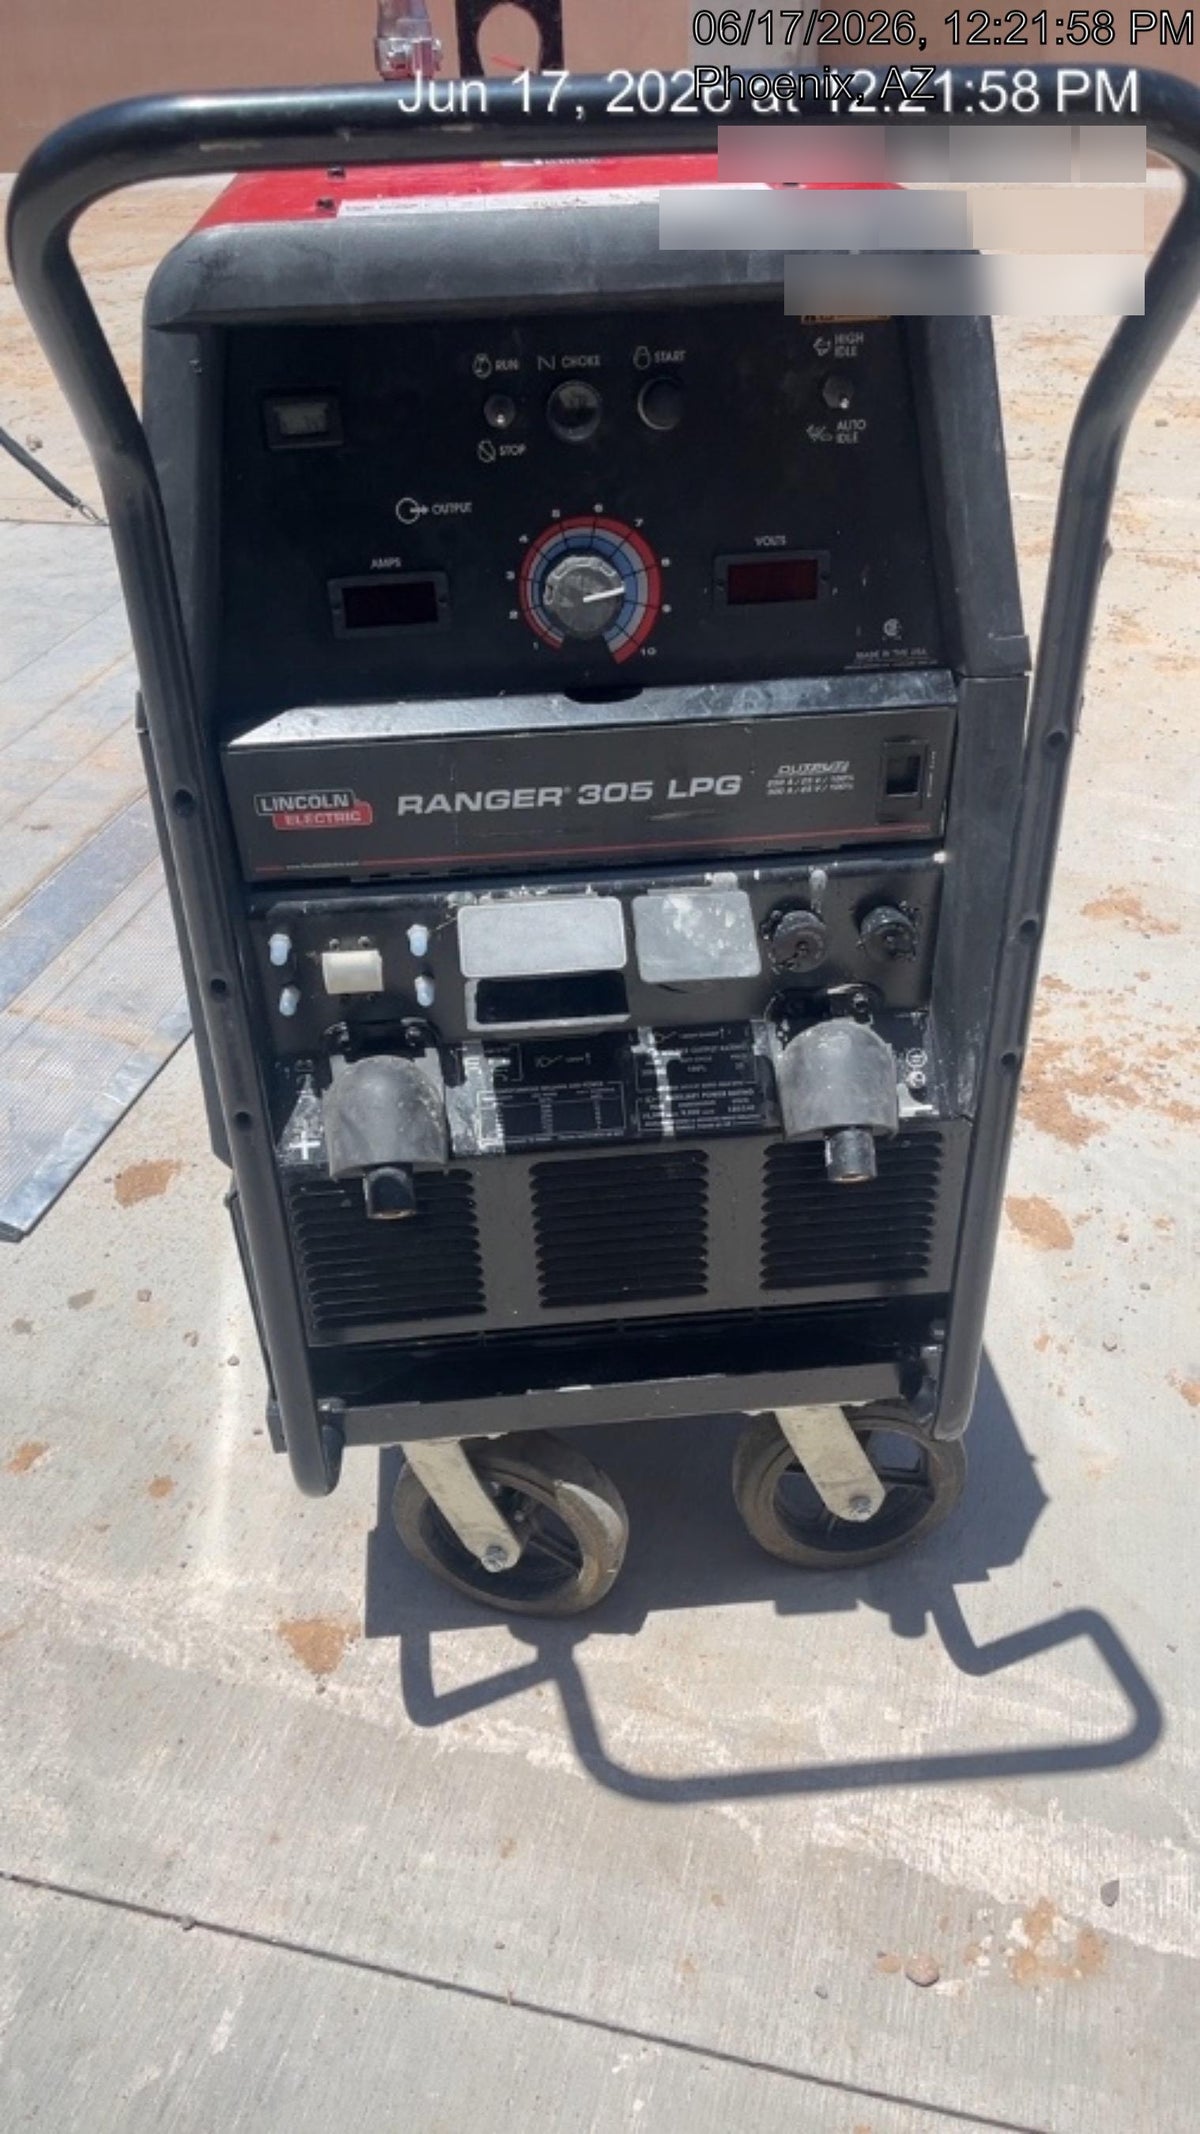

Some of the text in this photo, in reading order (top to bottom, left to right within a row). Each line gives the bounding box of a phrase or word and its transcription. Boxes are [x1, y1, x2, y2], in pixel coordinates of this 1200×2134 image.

[834, 331, 864, 344] HIGH
[561, 355, 600, 369] CHOKE
[654, 350, 687, 364] START
[495, 359, 520, 371] RUN
[836, 419, 866, 431] AUTO
[499, 443, 527, 457] STOP
[431, 501, 473, 516] OUTPUT
[754, 535, 787, 547] VOLTS
[370, 556, 402, 569] AMPS
[641, 646, 657, 656] 10
[577, 780, 653, 806] 305
[668, 774, 743, 799] LPG
[261, 793, 350, 812] LINCOLN
[285, 810, 361, 826] ELECTRIC
